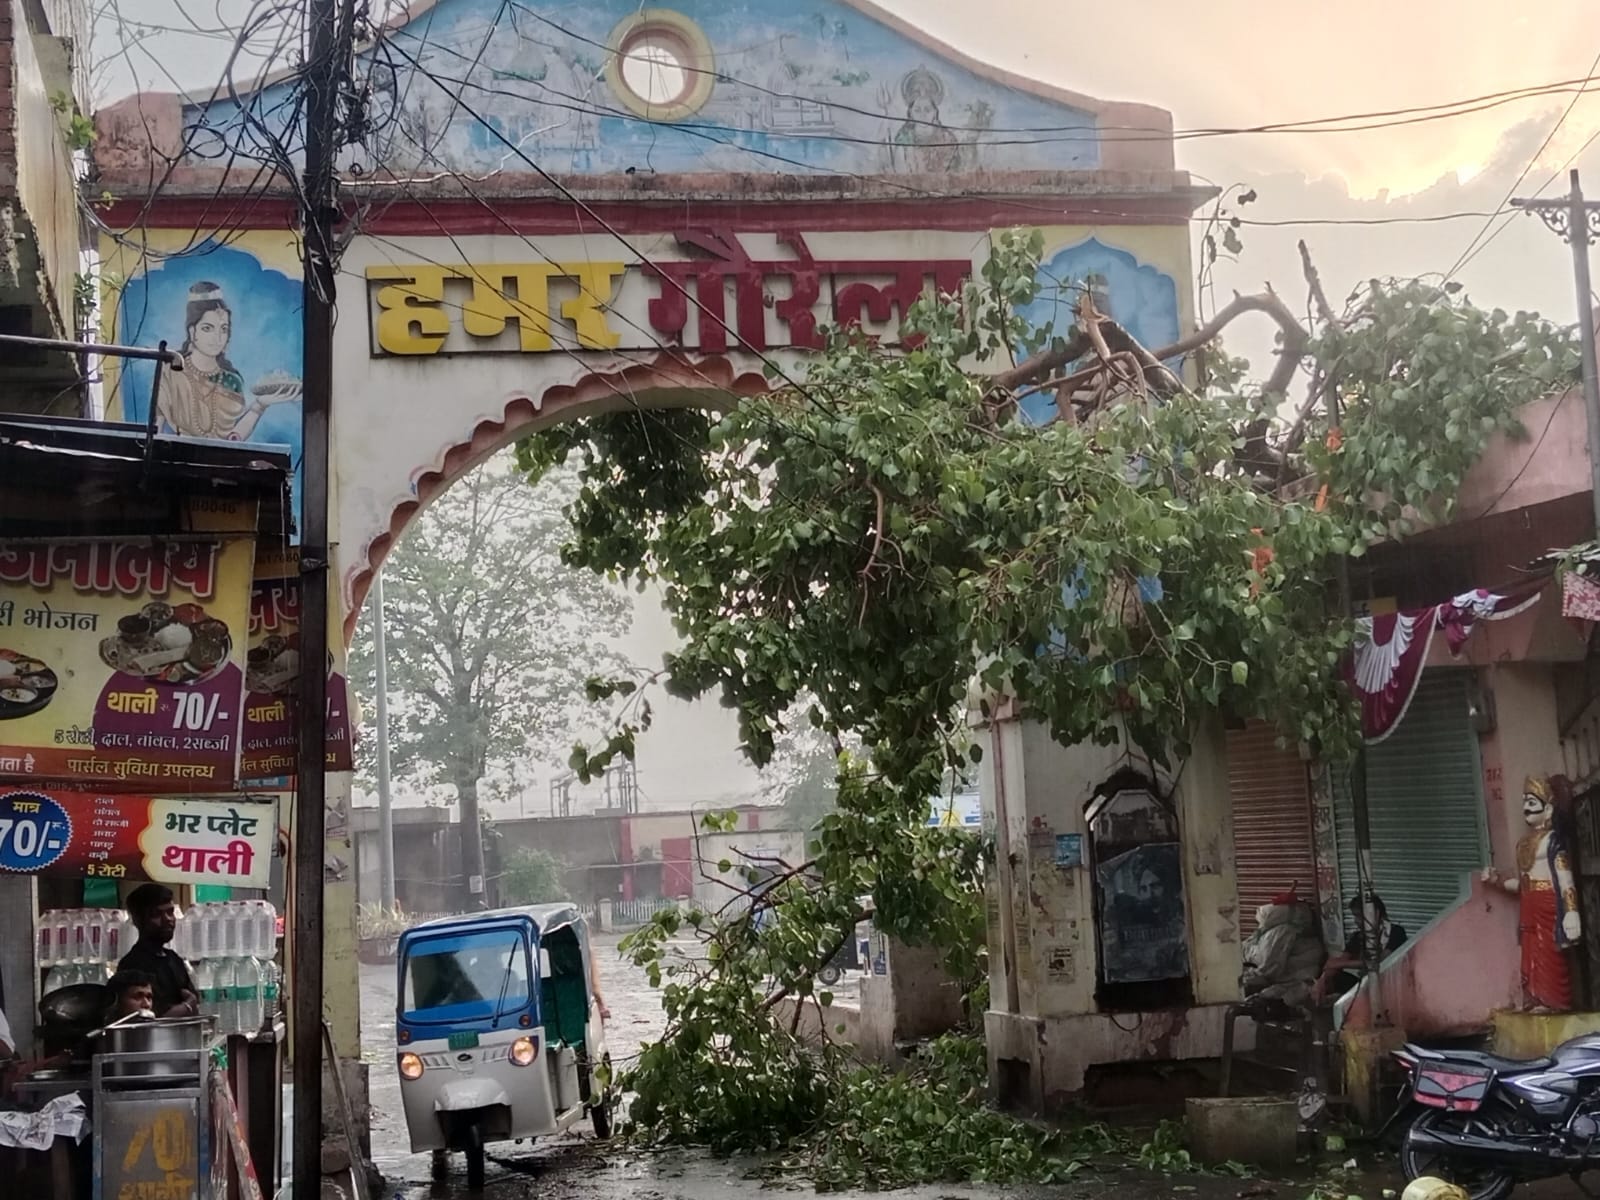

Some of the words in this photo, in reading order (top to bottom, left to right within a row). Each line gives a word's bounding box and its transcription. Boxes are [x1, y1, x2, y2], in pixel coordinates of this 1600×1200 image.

[366, 262, 626, 355] हमर
[24, 600, 100, 632] भोजन
[107, 688, 159, 714] थाली
[172, 692, 229, 732] 70/-
[247, 700, 285, 724] थाली
[23, 753, 36, 773] है
[66, 756, 110, 775] पार्सल
[113, 758, 159, 780] सुविधा
[162, 763, 215, 779] उपलब्ध
[260, 754, 295, 774] सुविधा
[12, 801, 42, 814] मात्र
[165, 812, 202, 834] भर
[207, 808, 259, 837] प्लेट
[87, 863, 95, 876] 5
[98, 862, 127, 878] रोटी
[161, 840, 255, 876] थाली
